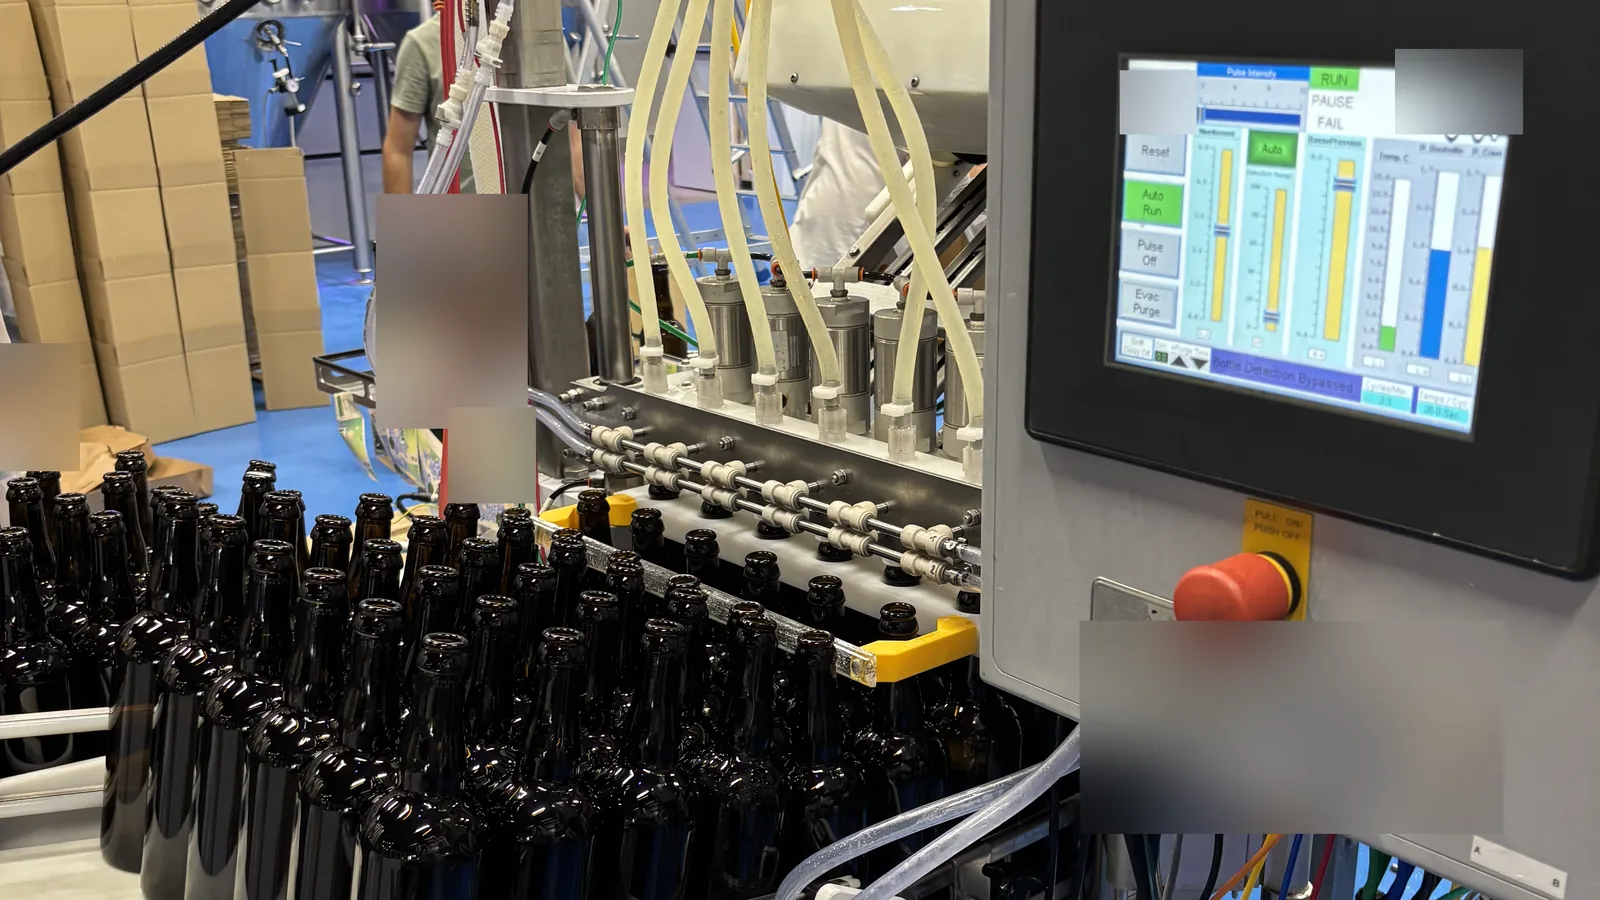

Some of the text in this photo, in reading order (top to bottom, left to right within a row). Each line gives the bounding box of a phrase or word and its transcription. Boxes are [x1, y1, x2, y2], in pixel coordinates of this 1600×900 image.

[1227, 67, 1277, 80] Pulse Intensity
[1321, 73, 1348, 87] RUN
[1311, 94, 1354, 109] PAUSE
[1317, 116, 1344, 130] FAIL
[1141, 144, 1170, 158] Reset
[1261, 144, 1283, 154] Auto
[1142, 188, 1164, 201] Auto
[1143, 204, 1162, 216] Run
[1137, 239, 1163, 252] Pulse
[1142, 255, 1158, 266] Off
[1135, 288, 1159, 302] Evac
[1133, 303, 1160, 318] Purge
[1212, 357, 1353, 394] Bottle Detection Bypassed
[1254, 510, 1277, 523] PULL
[1253, 522, 1300, 541] PUSH OFF
[1473, 846, 1482, 855] A
[1552, 878, 1560, 888] B
